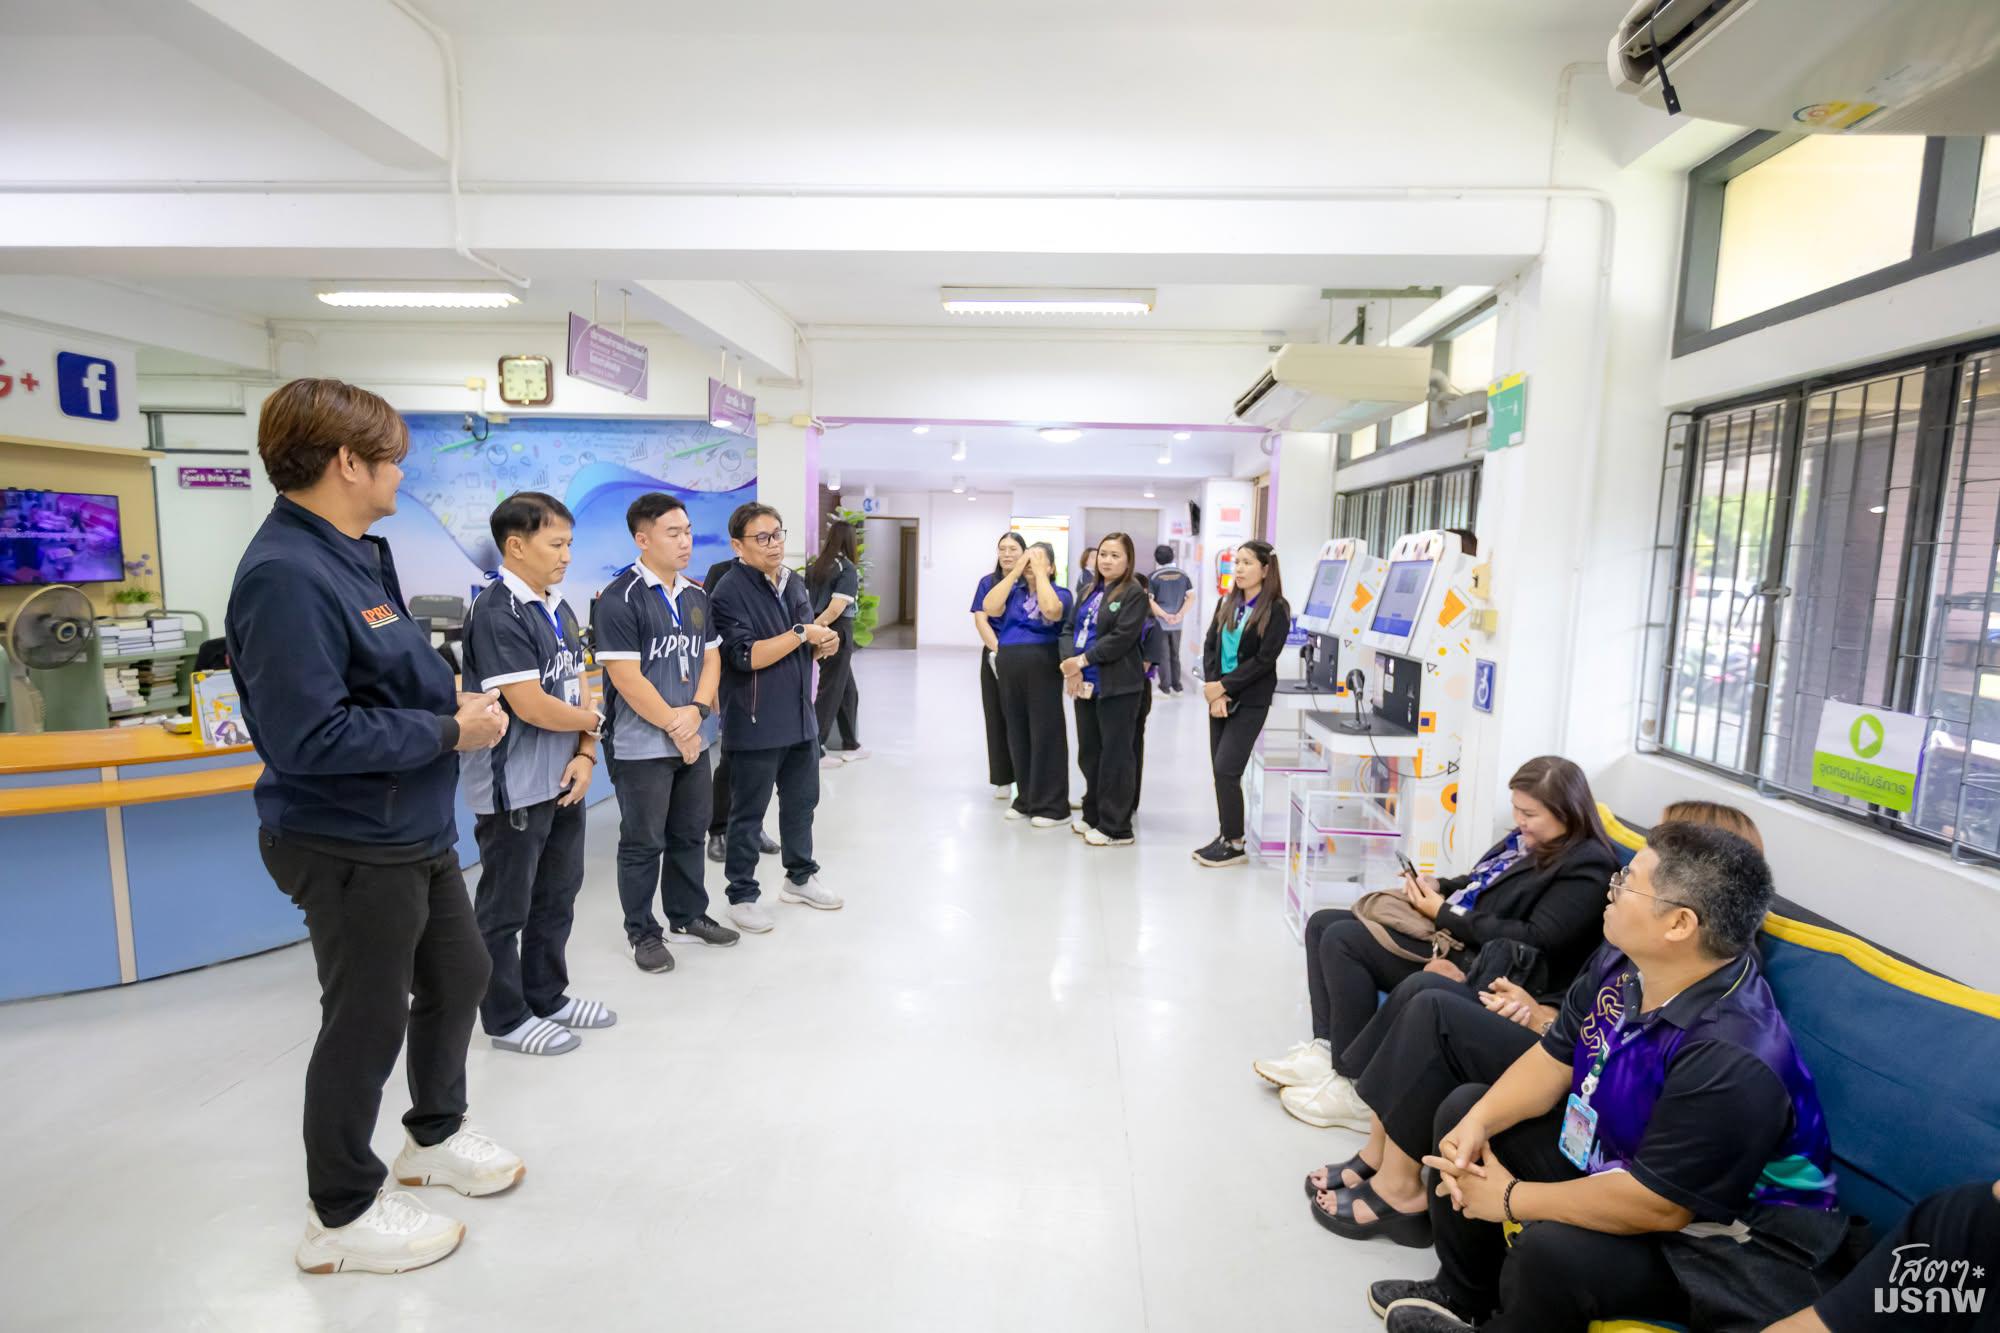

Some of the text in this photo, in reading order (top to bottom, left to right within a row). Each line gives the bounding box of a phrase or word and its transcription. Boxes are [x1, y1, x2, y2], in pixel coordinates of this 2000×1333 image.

[82, 363, 106, 414] f
[361, 603, 393, 623] KPRU
[649, 634, 701, 661] KPRU
